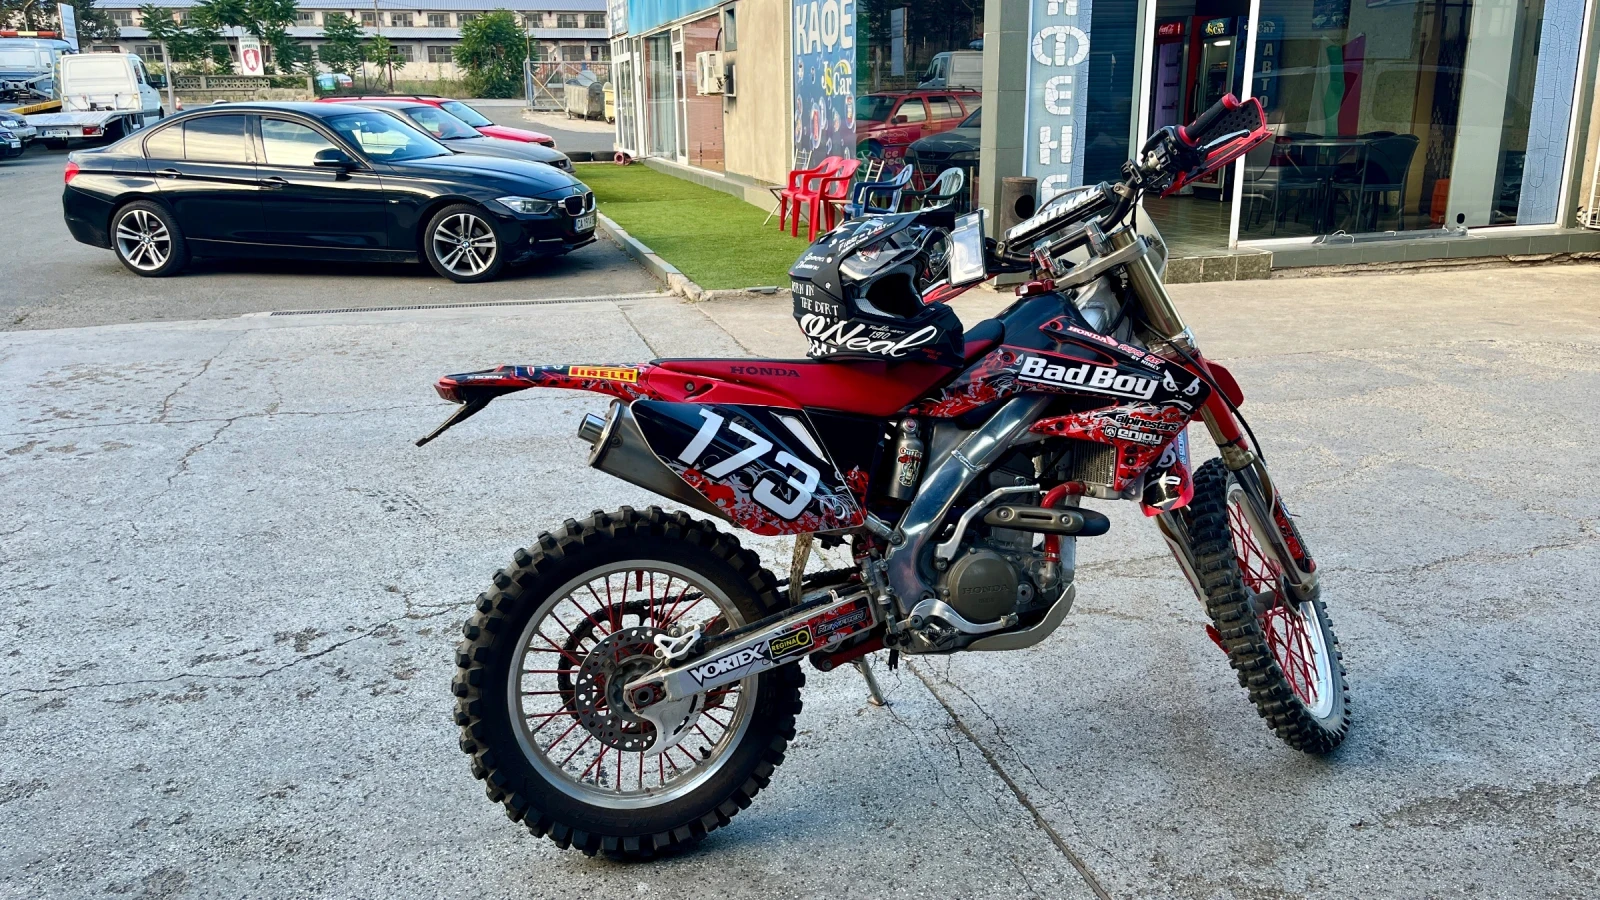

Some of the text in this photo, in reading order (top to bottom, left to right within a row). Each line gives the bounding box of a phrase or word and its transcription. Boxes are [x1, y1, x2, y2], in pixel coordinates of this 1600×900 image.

[796, 0, 853, 55] КАФЕ
[800, 297, 839, 317] THE DIRT
[868, 331, 890, 340] 1970
[1067, 325, 1107, 344] HONDA
[570, 366, 637, 382] PIRELLI
[730, 366, 800, 378] HONDA
[1019, 356, 1090, 385] Bad
[1088, 366, 1160, 399] Boy
[1116, 414, 1179, 431] alpinestars
[1117, 428, 1163, 445] enjoy
[678, 407, 820, 520] 173
[962, 583, 1010, 595] HONDA
[771, 638, 797, 651] REGINA
[689, 642, 766, 686] VORTEX
